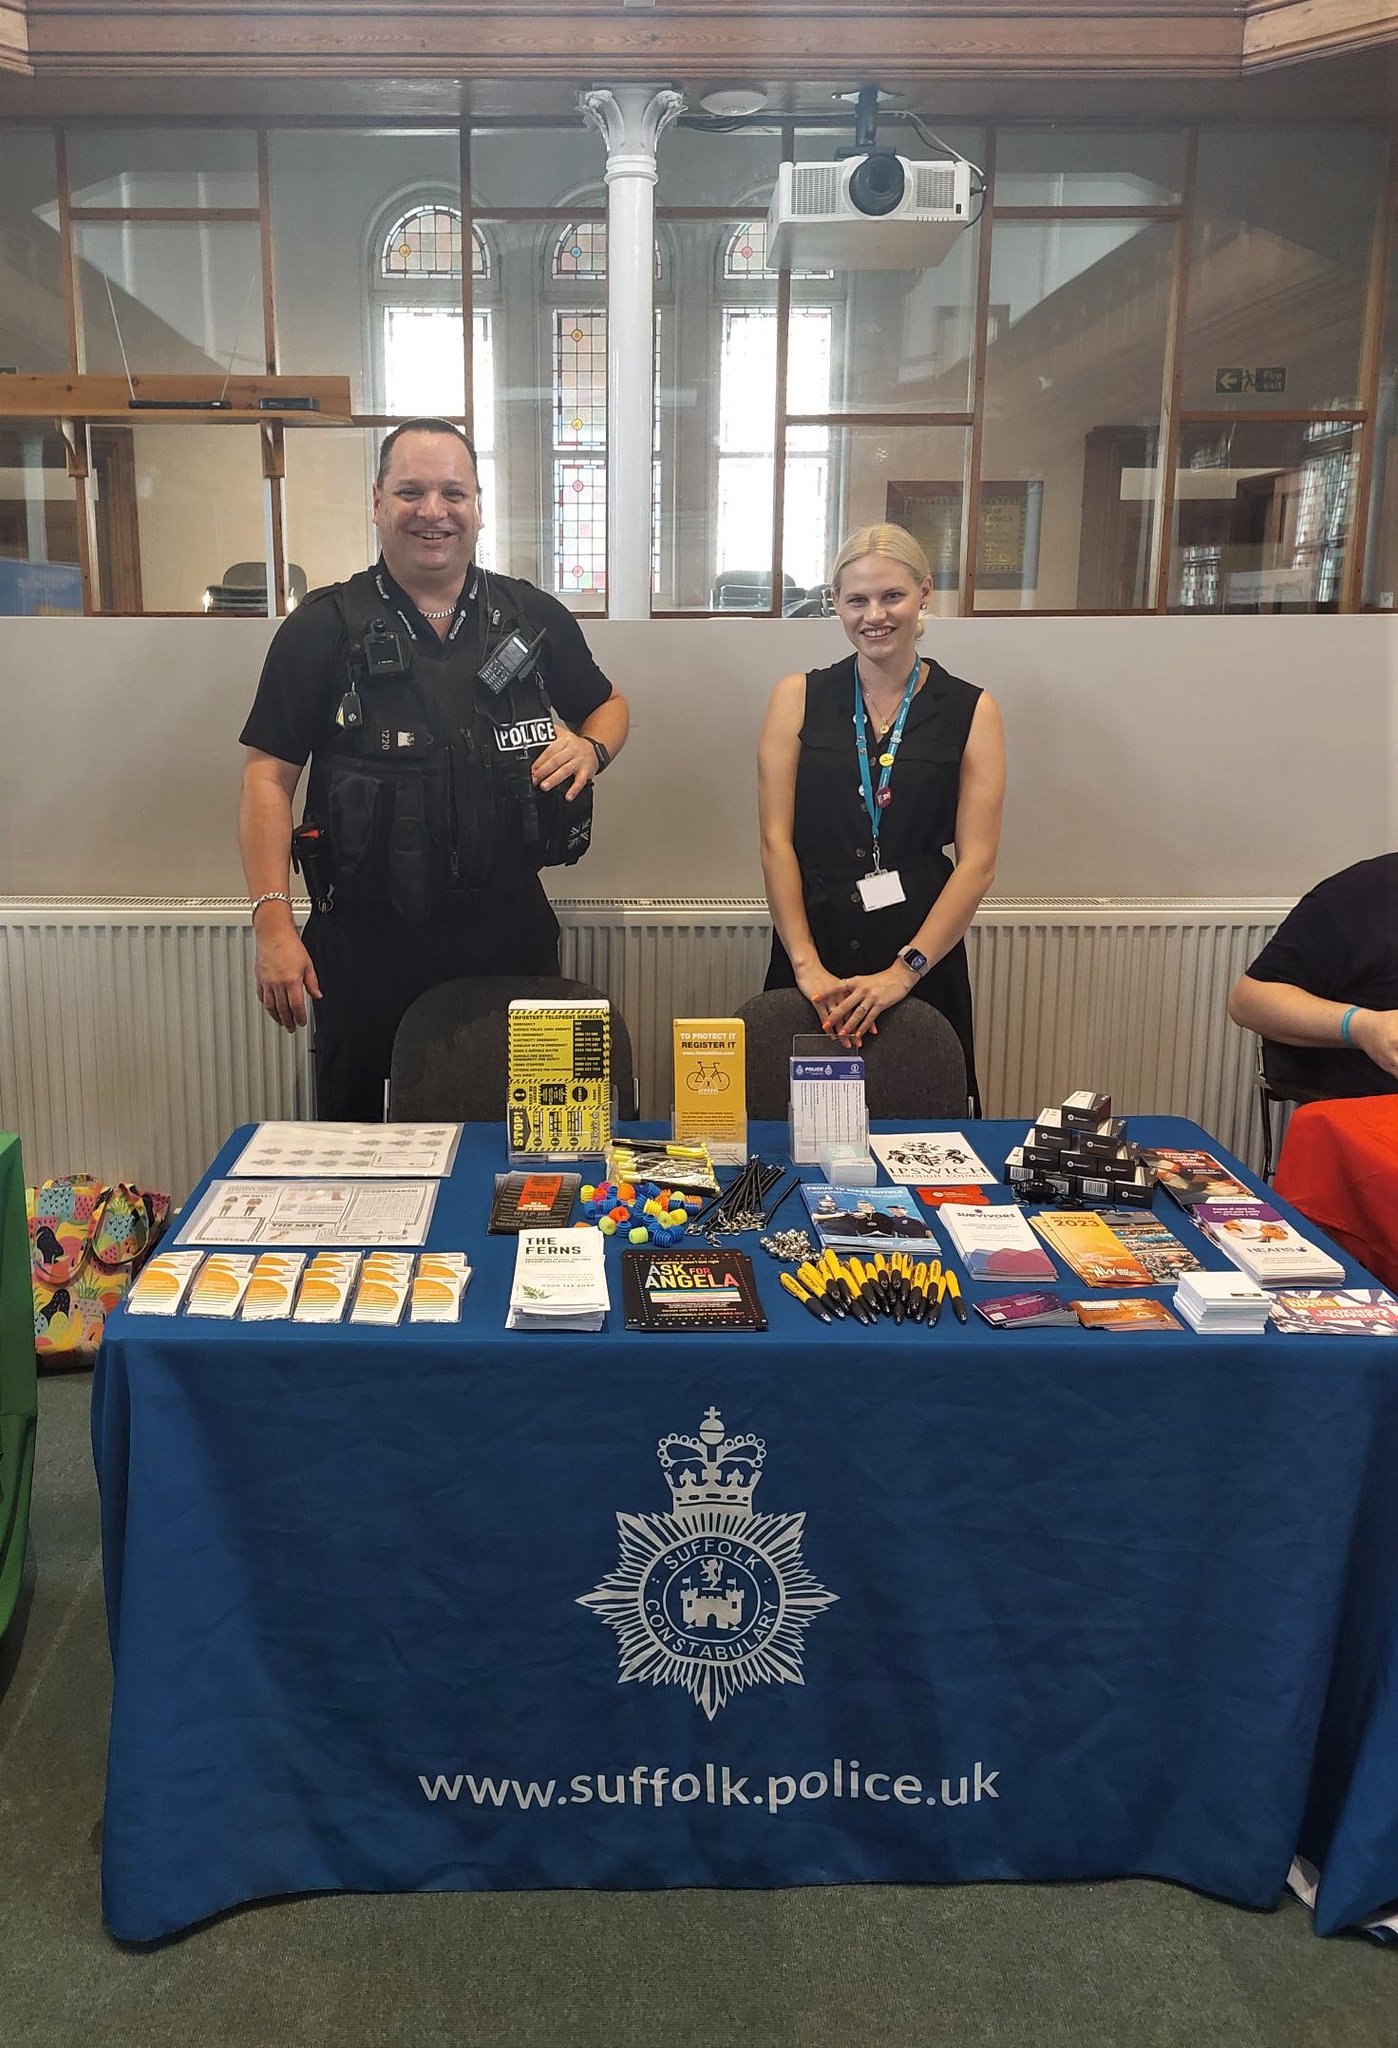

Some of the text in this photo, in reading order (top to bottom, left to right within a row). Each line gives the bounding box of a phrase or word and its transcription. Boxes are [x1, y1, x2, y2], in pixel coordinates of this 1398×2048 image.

[382, 730, 390, 750] 1220
[501, 722, 556, 747] POLICE
[514, 1112, 524, 1146] STOP!
[526, 1246, 581, 1254] FERNS
[645, 1273, 740, 1288] ANGELA
[648, 1264, 686, 1275] ASK
[663, 1538, 762, 1571] SUFFOLK
[644, 1599, 778, 1660] CONSTABULARY
[418, 1758, 1000, 1814] www.suffolk.police.uk
